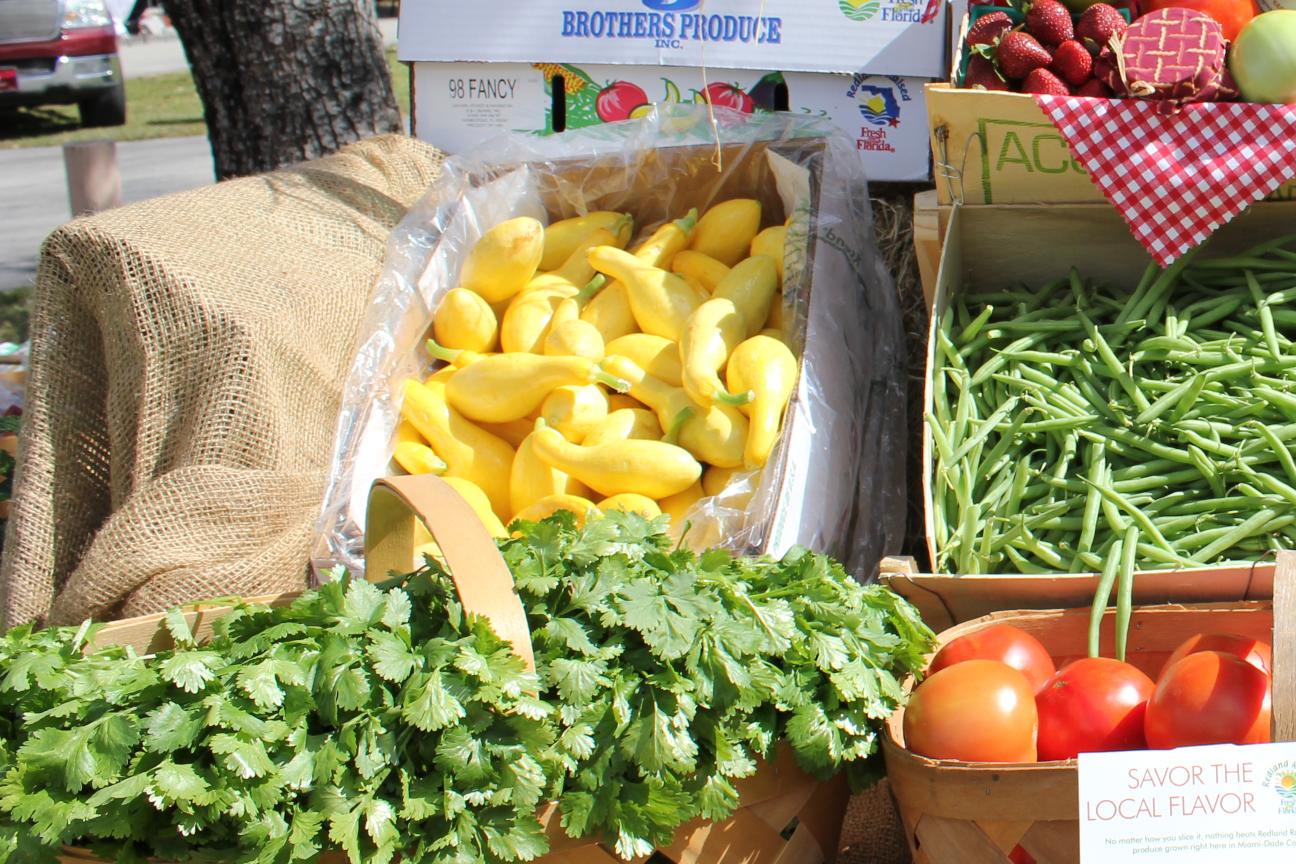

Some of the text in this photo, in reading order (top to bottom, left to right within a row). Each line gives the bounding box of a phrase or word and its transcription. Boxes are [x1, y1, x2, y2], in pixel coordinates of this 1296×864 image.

[881, 8, 928, 23] Florid
[561, 11, 783, 43] BROTHERS PRODUCE
[655, 40, 683, 49] INC.
[449, 78, 516, 99] 98 FANCY
[861, 127, 886, 138] Fresh
[856, 139, 892, 151] Florida
[1128, 762, 1253, 789] SAVOR THE
[1261, 760, 1289, 787] Redland
[1087, 792, 1256, 821] LOCAL FLAVOR
[1105, 837, 1117, 845] No
[1119, 836, 1143, 845] matter
[1145, 834, 1161, 843] how
[1162, 836, 1177, 844] you
[1179, 833, 1194, 841] slice
[1205, 831, 1234, 840] nothing
[1258, 829, 1288, 837] Redland
[1132, 846, 1163, 855] produce
[1165, 845, 1189, 853] grown
[1191, 842, 1208, 852] right
[1210, 841, 1227, 849] here
[1238, 839, 1284, 848] Miami-Dade
